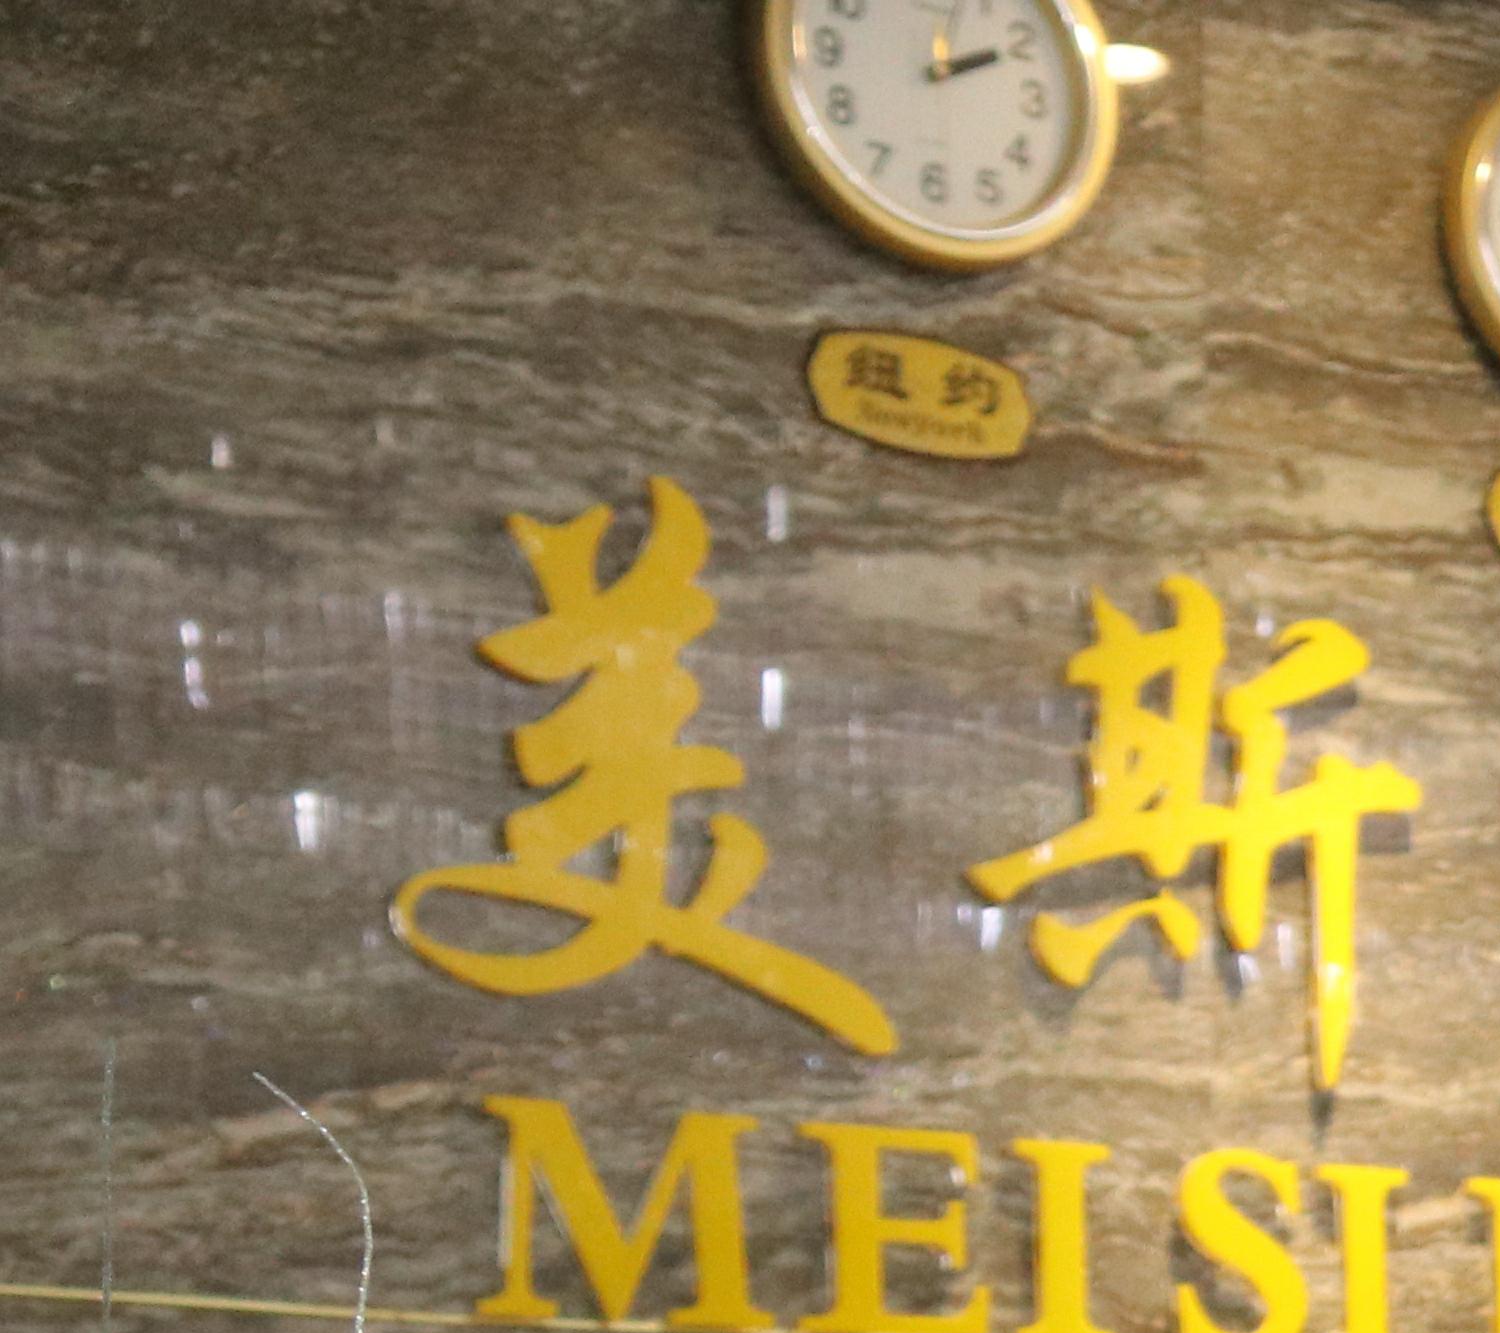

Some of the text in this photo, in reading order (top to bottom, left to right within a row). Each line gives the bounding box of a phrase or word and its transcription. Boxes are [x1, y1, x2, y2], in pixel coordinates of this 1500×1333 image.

[813, 25, 844, 67] 9
[1006, 20, 1036, 61] 2
[826, 84, 857, 126] 8
[1020, 79, 1047, 119] 3
[864, 139, 892, 178] 7
[1005, 133, 1031, 170] 4
[919, 161, 947, 203] 6
[974, 168, 1003, 204] 5
